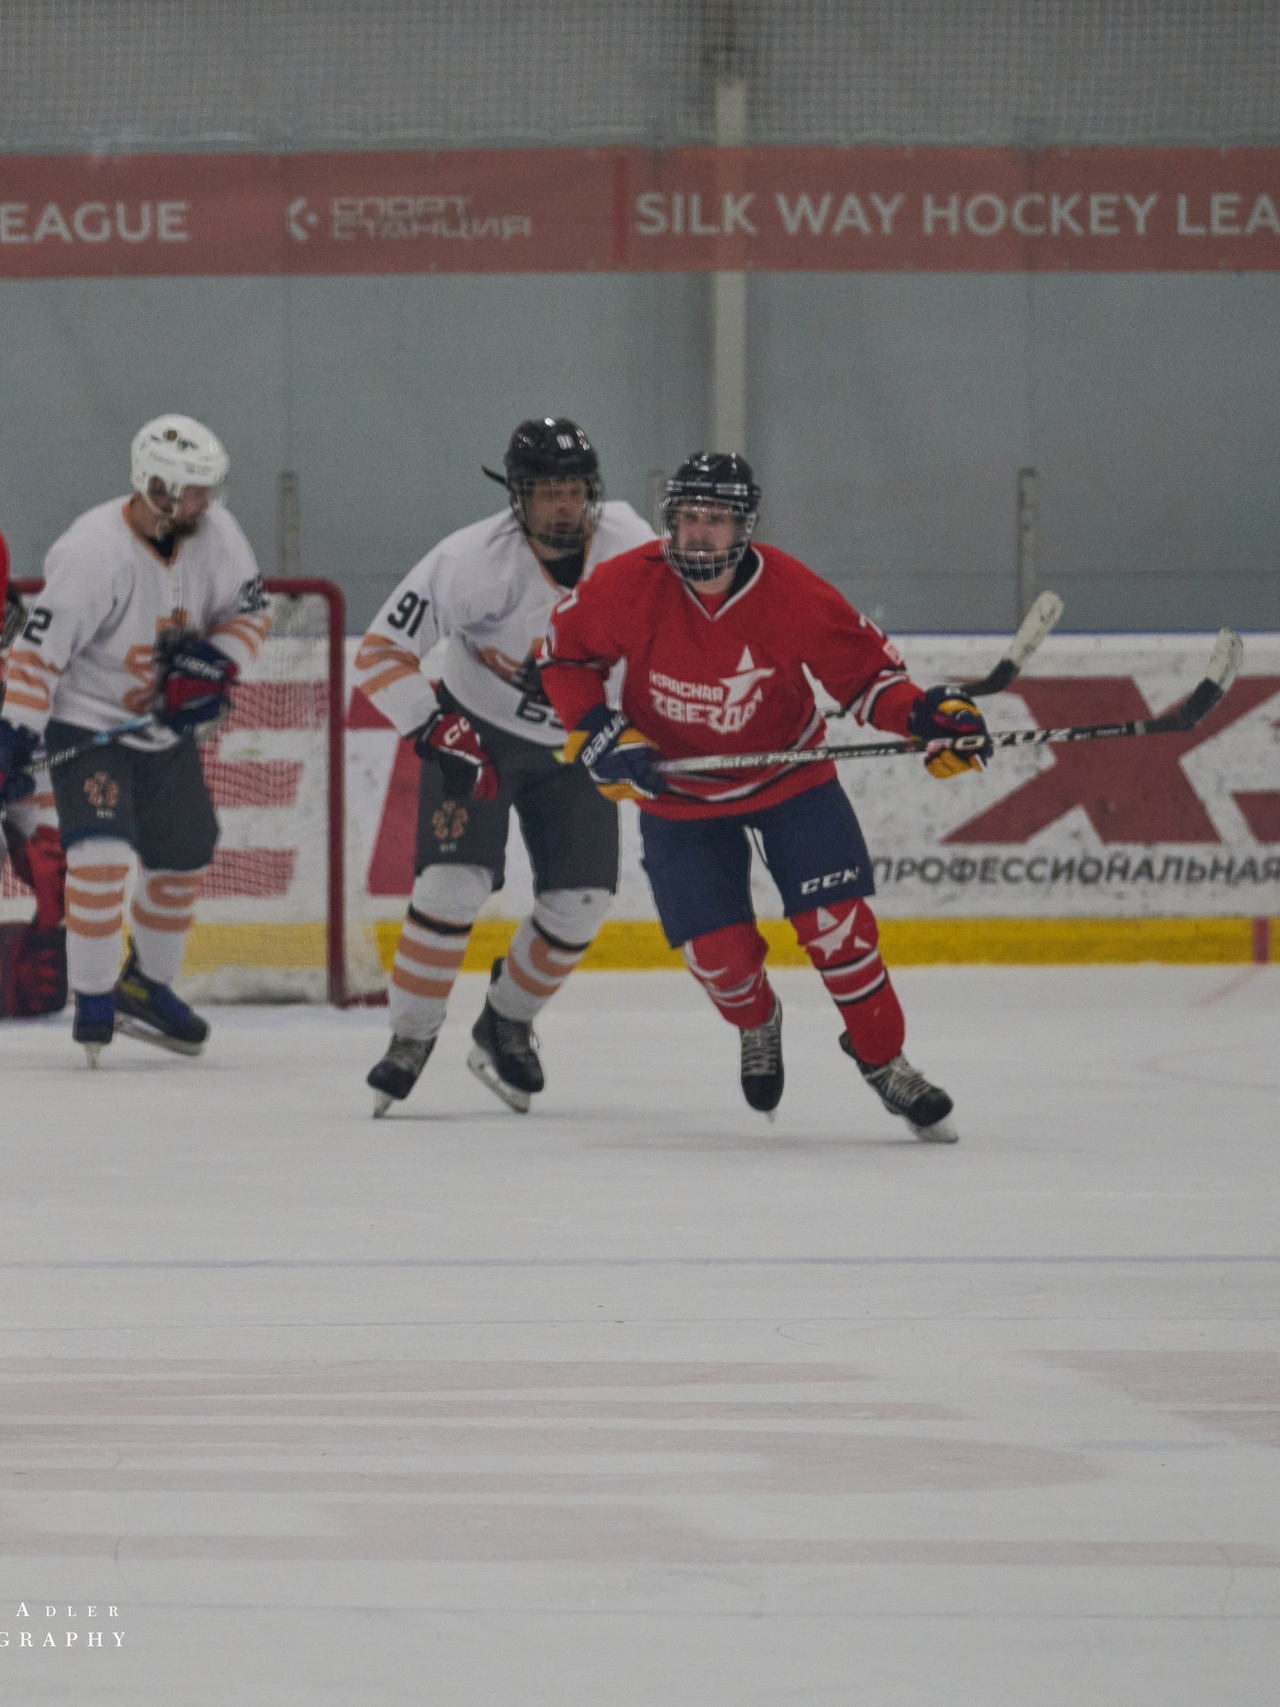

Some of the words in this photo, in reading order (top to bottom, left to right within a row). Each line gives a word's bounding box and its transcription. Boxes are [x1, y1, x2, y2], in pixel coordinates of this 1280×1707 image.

[635, 192, 758, 236] SILK
[774, 193, 906, 235] WAY
[922, 192, 1158, 236] HOCKEY
[1177, 193, 1280, 236] LEA
[386, 590, 429, 639] 91
[870, 855, 1280, 885] ПРОФЕССИОНАЛЬНАЯ
